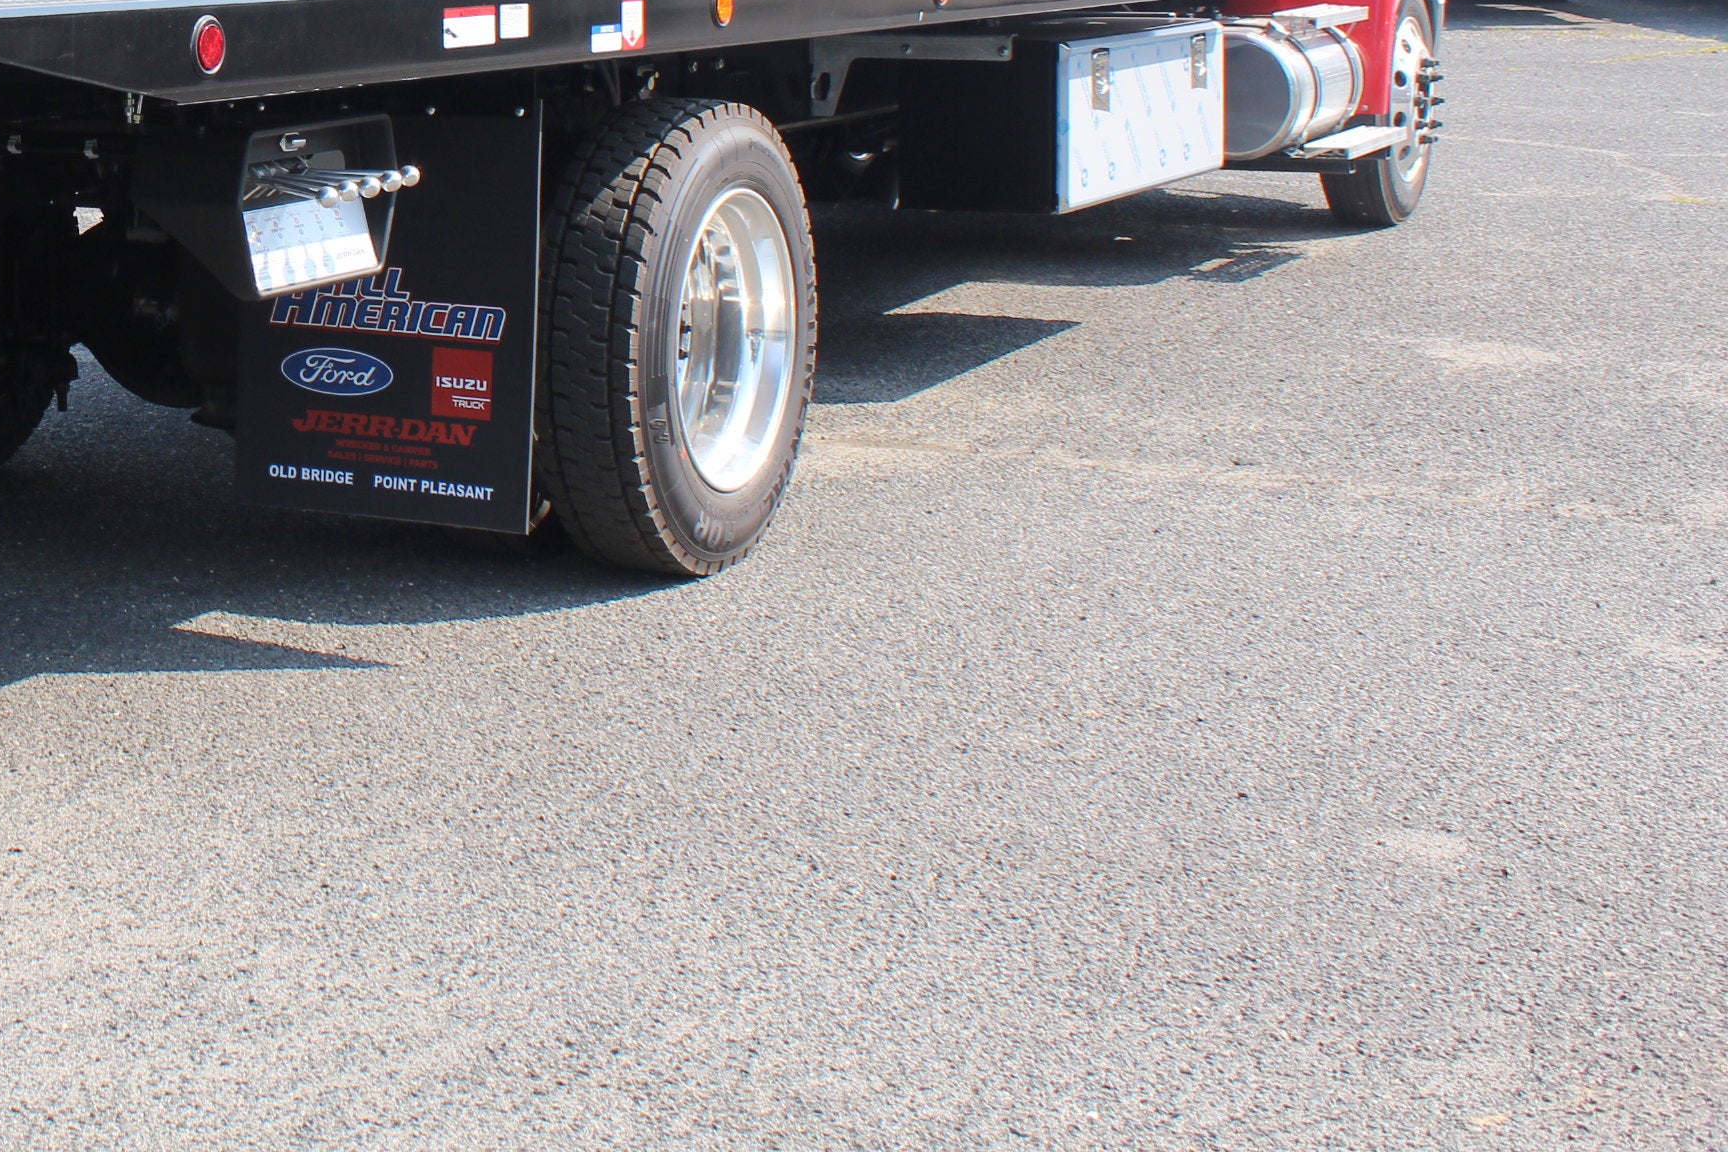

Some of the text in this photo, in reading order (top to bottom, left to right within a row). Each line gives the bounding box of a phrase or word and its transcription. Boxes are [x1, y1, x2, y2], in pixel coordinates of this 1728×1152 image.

[270, 287, 507, 341] AMERICAN
[299, 354, 376, 387] Ford
[435, 376, 488, 392] ISUZU
[452, 399, 485, 410] TRUCK
[291, 409, 478, 447] JERR-DAN
[269, 464, 354, 485] OLD BRIDGE
[374, 475, 494, 501] POINT PLEASANT
